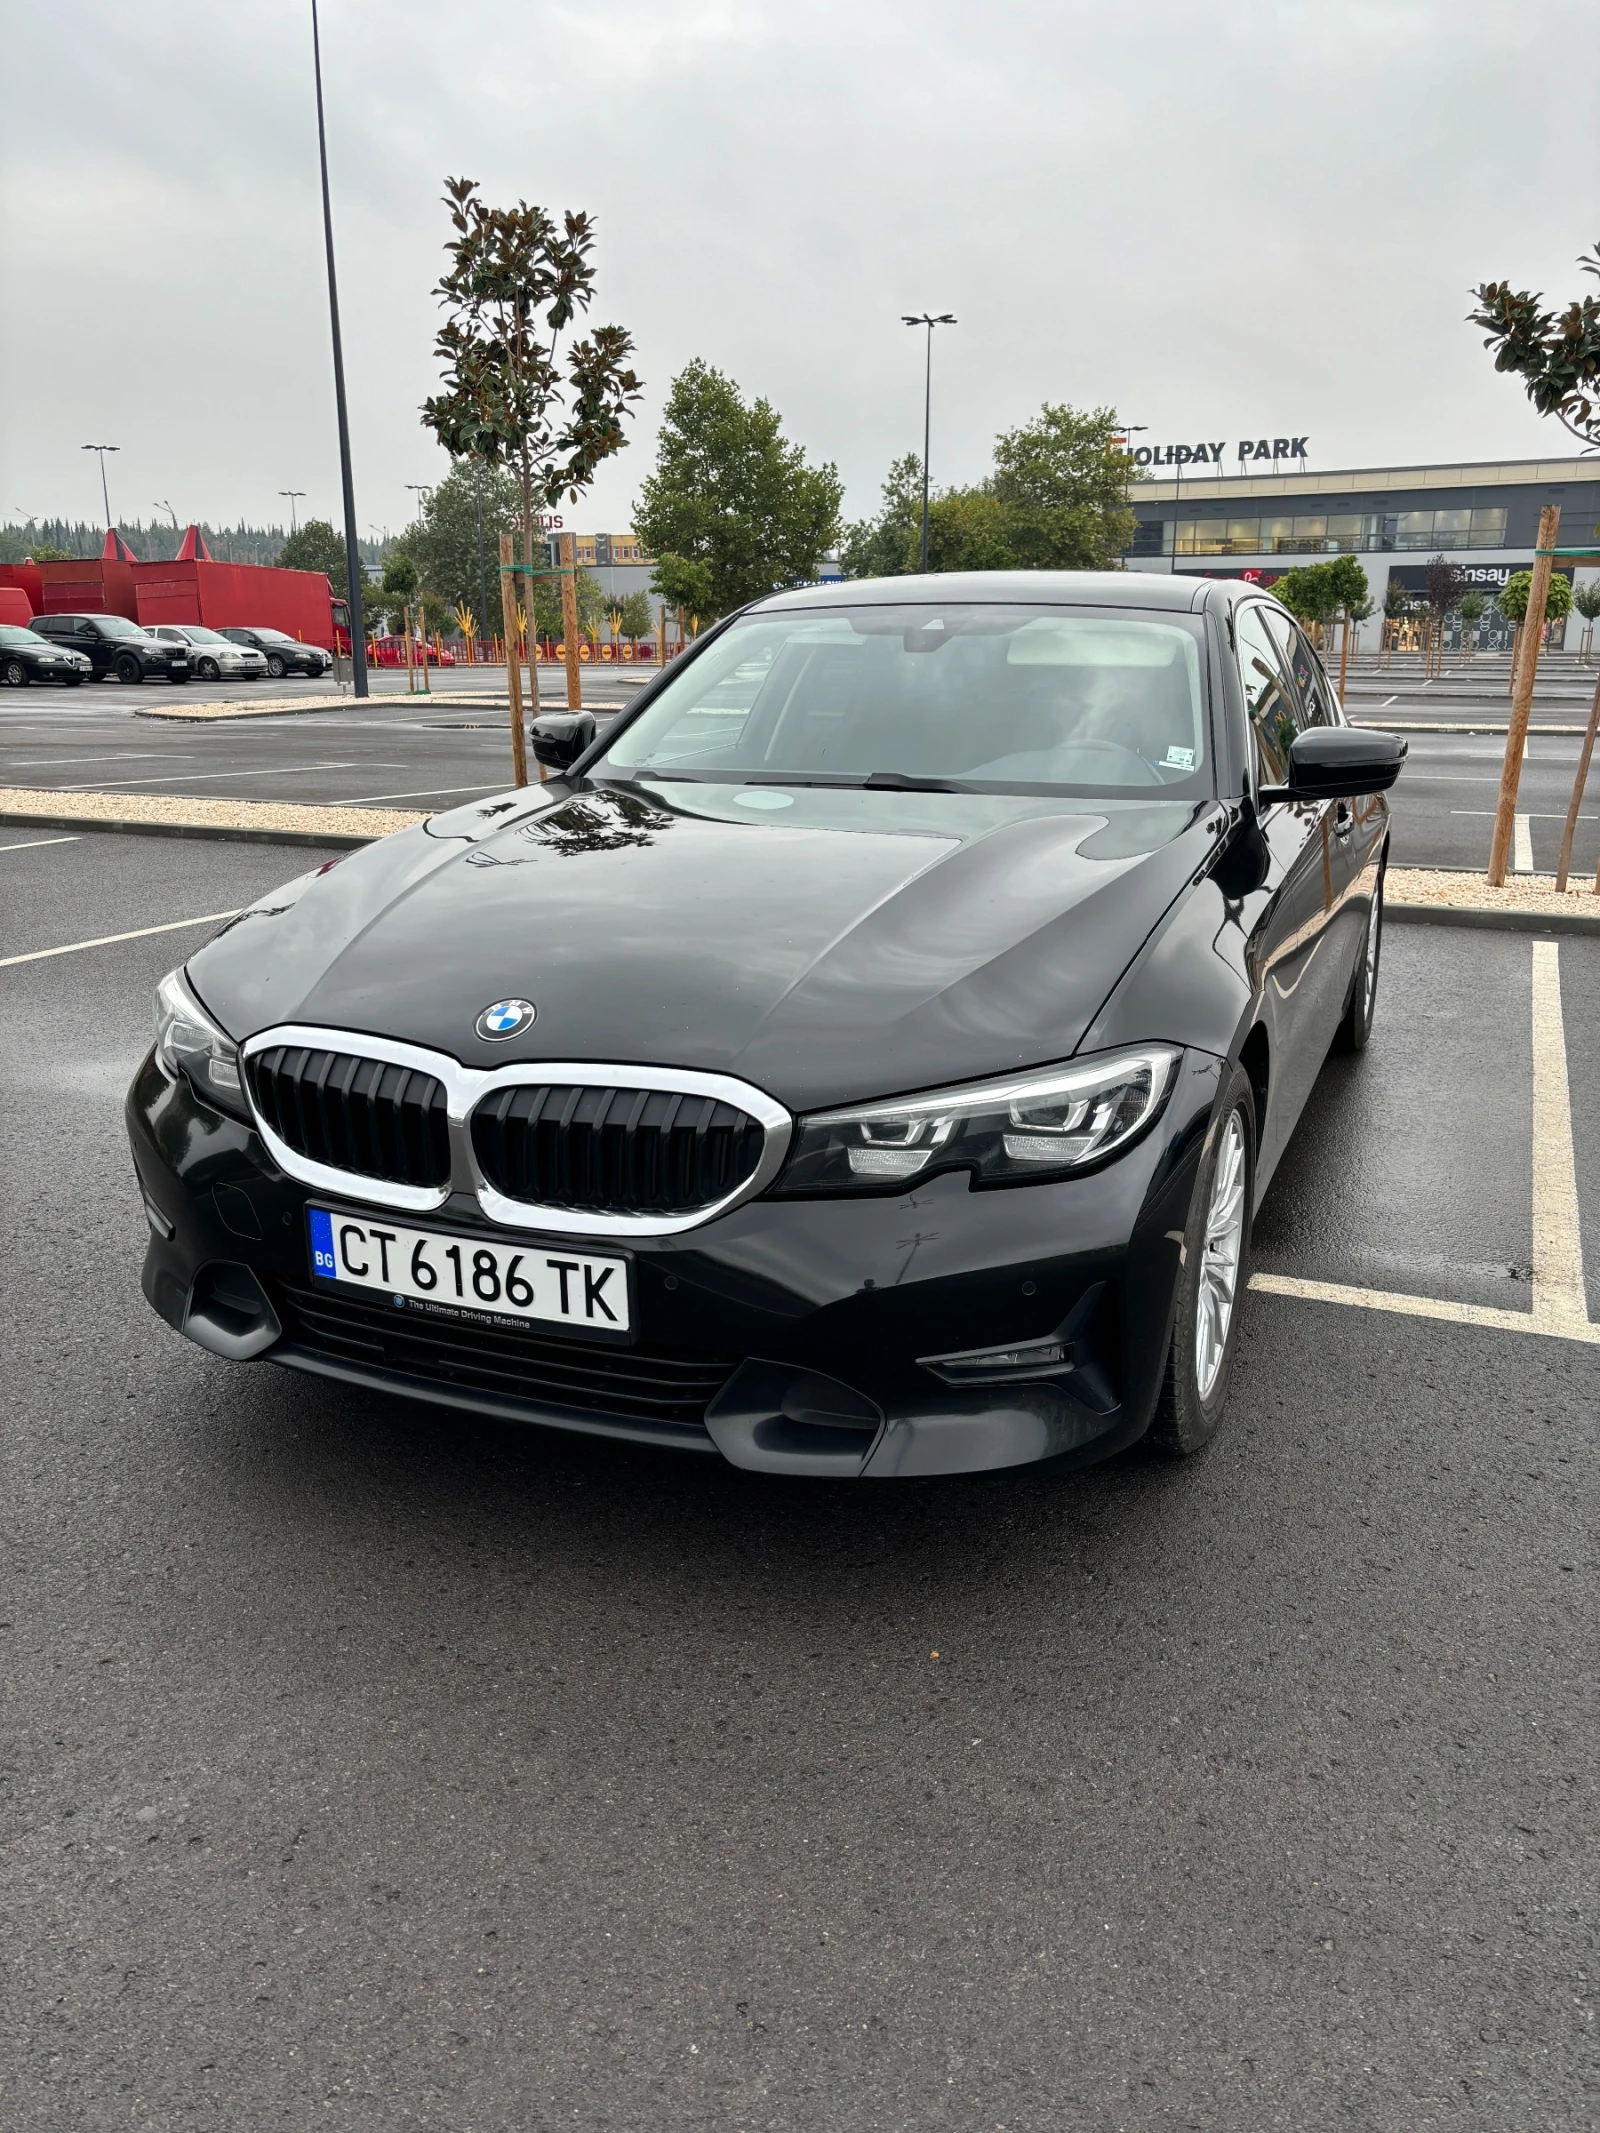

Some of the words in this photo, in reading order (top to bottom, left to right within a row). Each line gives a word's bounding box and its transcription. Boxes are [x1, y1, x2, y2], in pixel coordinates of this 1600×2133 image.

[1238, 437, 1310, 461] PARK
[316, 1251, 334, 1268] BG
[340, 1224, 396, 1283] CT
[411, 1239, 534, 1307] 6186
[546, 1259, 619, 1321] TK
[408, 1299, 424, 1310] The
[425, 1303, 459, 1317] Ultimate
[461, 1310, 492, 1324] Driving
[493, 1316, 530, 1329] Machine
